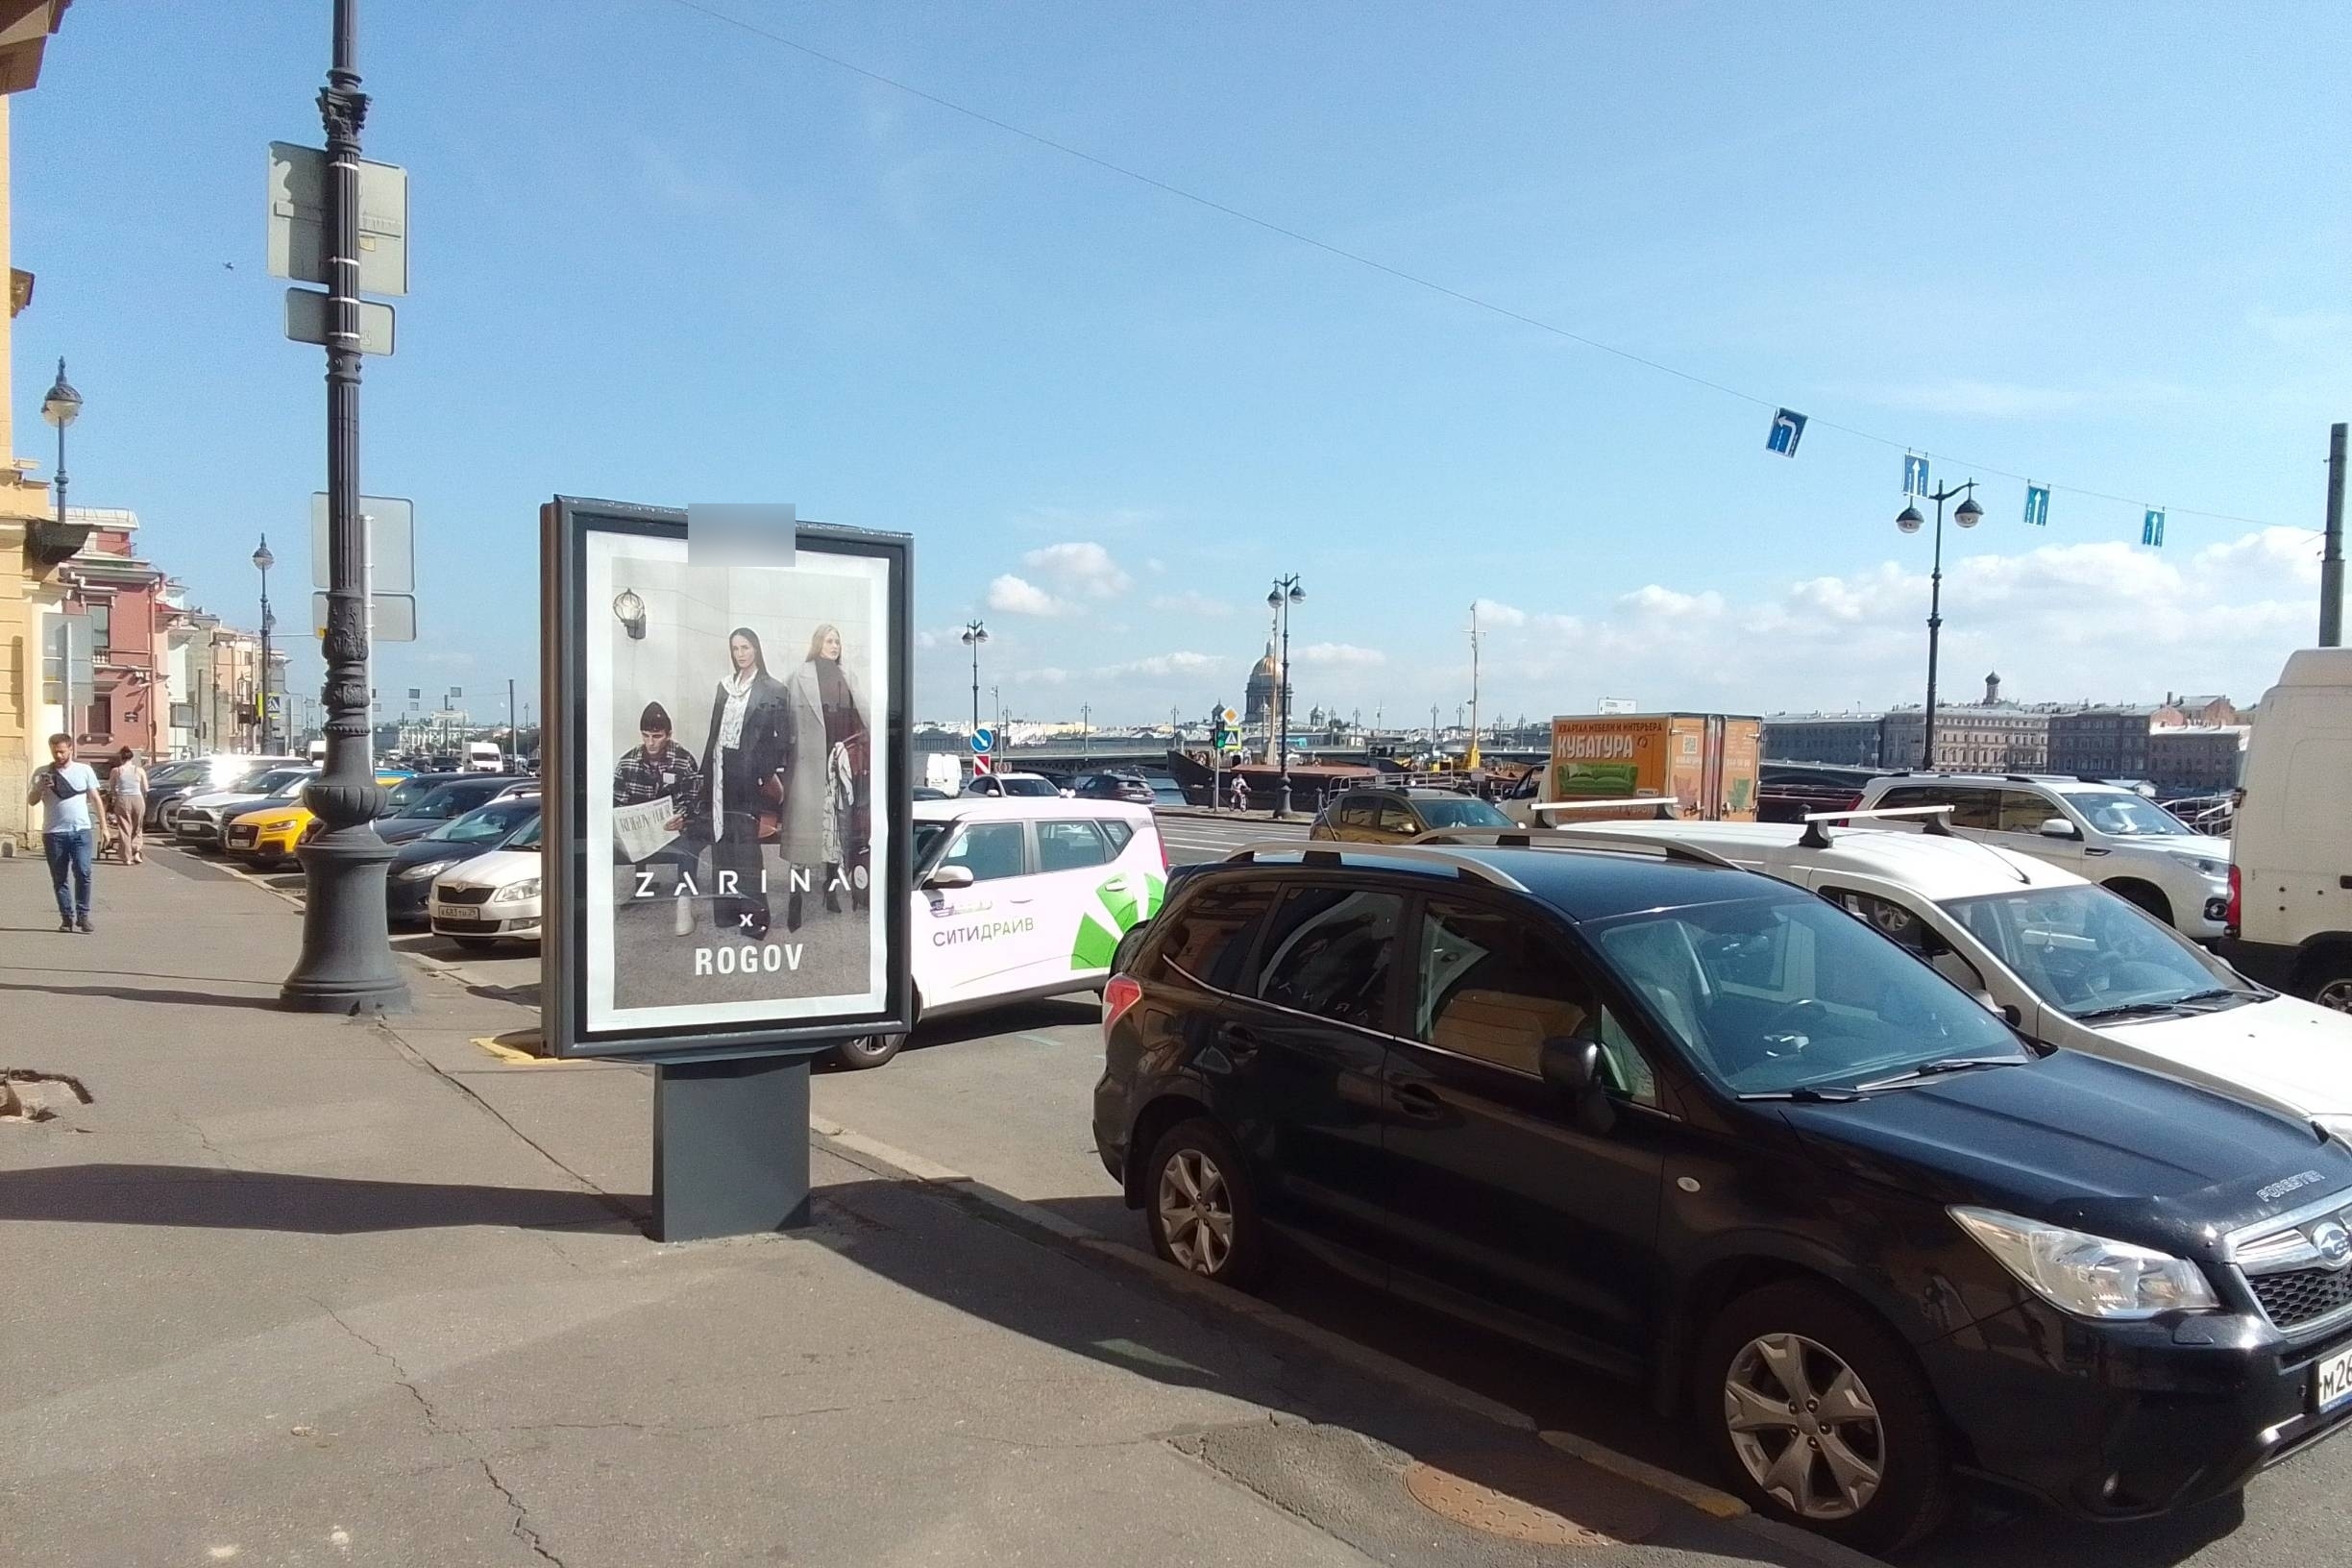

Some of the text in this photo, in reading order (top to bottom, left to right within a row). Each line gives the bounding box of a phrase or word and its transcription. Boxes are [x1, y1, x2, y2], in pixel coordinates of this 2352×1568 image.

[1556, 734, 1633, 759] КУБАТУРА
[635, 869, 851, 897] ZARINA
[695, 943, 803, 976] ROGOV
[2256, 1169, 2326, 1203] FORESTER
